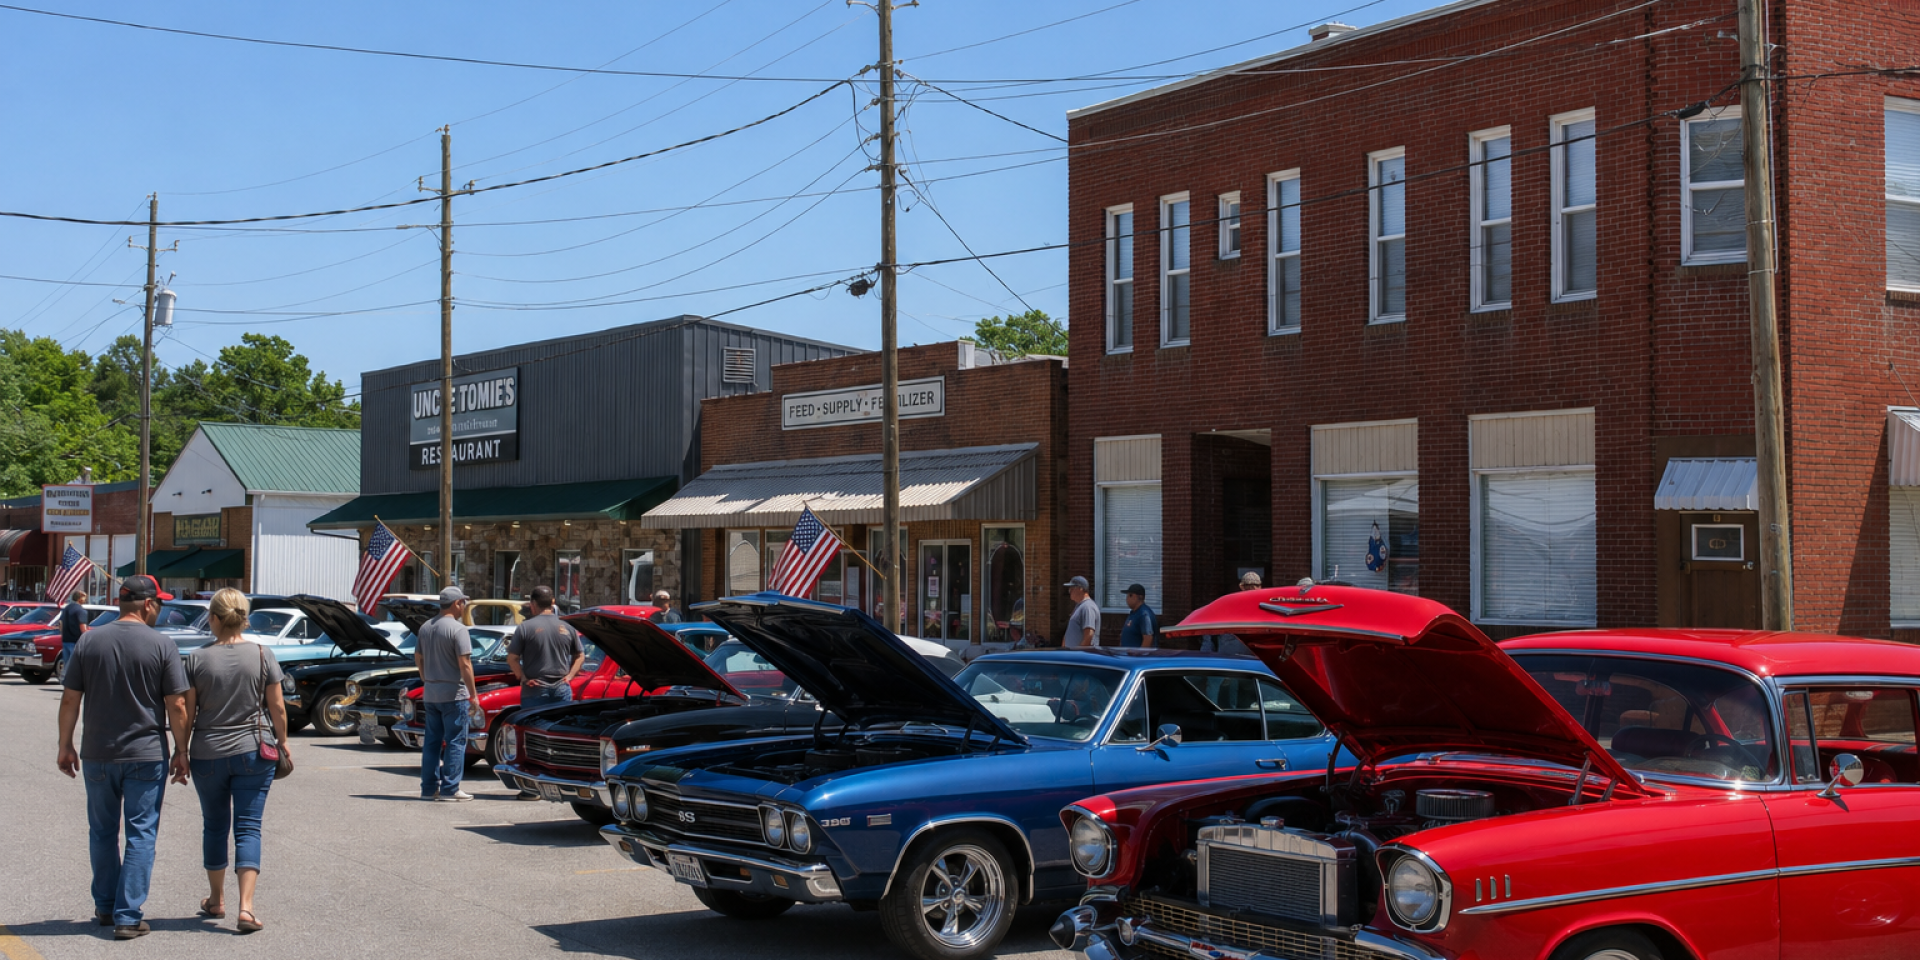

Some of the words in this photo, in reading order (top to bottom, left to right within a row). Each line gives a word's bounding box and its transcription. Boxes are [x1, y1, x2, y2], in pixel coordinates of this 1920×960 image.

[413, 386, 456, 419] UNCE
[459, 377, 516, 412] TOMIE'S
[789, 403, 815, 419] FEED
[822, 398, 862, 415] SUPPLY
[871, 390, 935, 411] FEILIZER
[421, 439, 501, 466] RESAURANT
